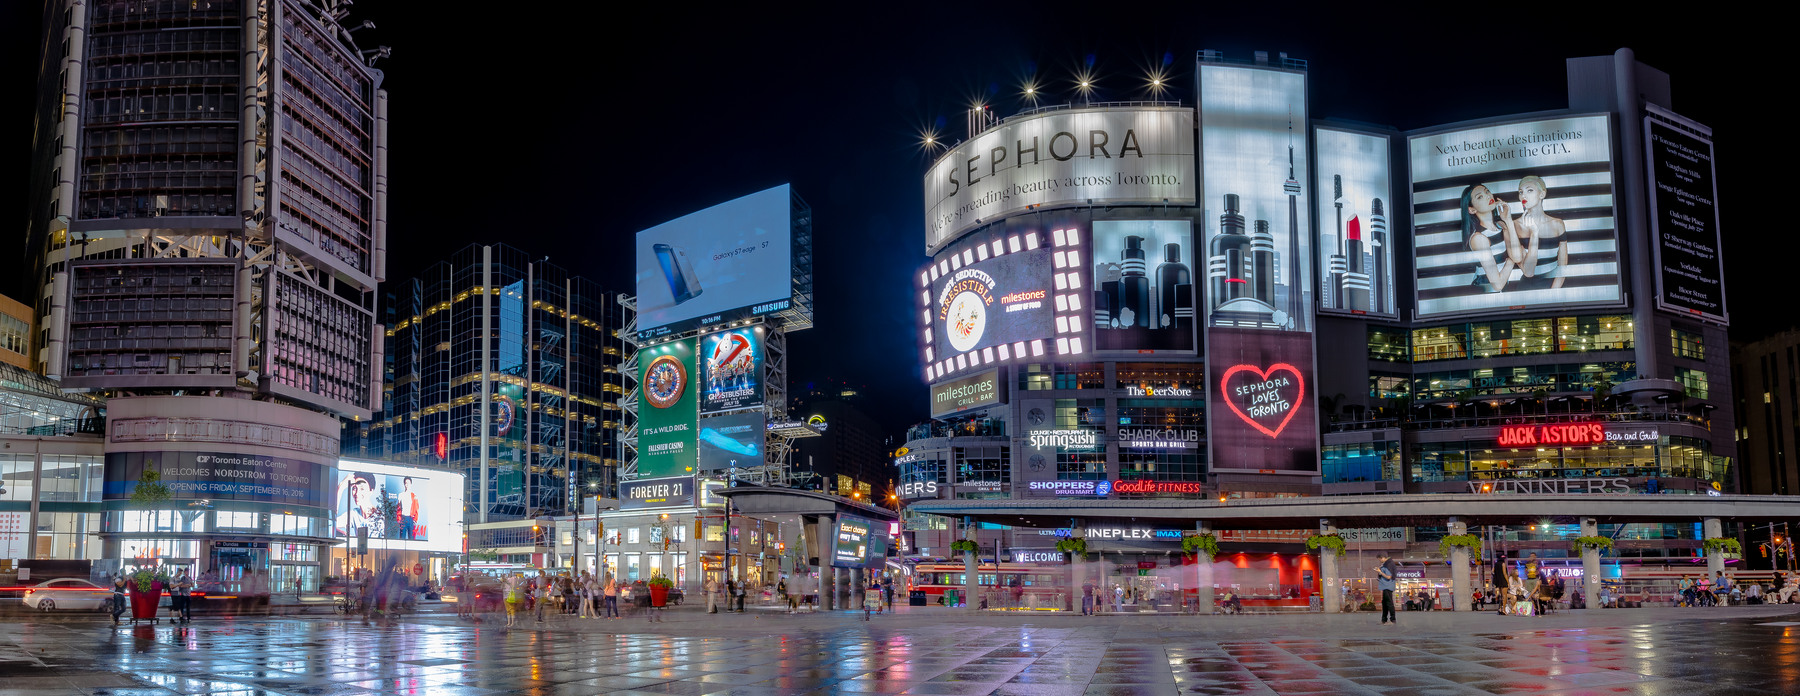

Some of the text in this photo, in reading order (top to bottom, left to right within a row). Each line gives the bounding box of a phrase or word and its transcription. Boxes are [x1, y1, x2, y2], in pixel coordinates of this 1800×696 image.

[1435, 129, 1583, 156] New beauty destinations
[1659, 136, 1680, 149] Toronto
[1679, 144, 1694, 155] Eaton
[1694, 150, 1711, 161] Centre
[1447, 143, 1571, 167] throughout the GTA.
[949, 128, 1143, 197] SEPHORA
[930, 171, 1181, 235] We're spreading beauty across Toronto.
[1695, 194, 1712, 206] Centre
[761, 240, 769, 249] S7
[1693, 241, 1714, 253] Gardens
[713, 246, 756, 261] Galaxy S7 edge
[955, 268, 996, 290] SEDUCTIVE
[940, 280, 994, 321] IRRESISTIBLE
[1001, 290, 1044, 304] milestones
[752, 300, 789, 315] SAMSUNG
[1480, 377, 1506, 387] DMZ
[1567, 373, 1594, 383] DMZ
[937, 379, 993, 403] milestones
[1126, 386, 1146, 396] The
[1236, 377, 1290, 396] SEPHORA
[957, 393, 993, 406] GRILL BAR
[1252, 388, 1280, 406] LOVES
[1247, 399, 1290, 419] TORONTO
[643, 428, 653, 436] IT'S
[658, 425, 674, 433] WILD
[674, 424, 689, 432] RIDE.
[1118, 429, 1198, 442] SHARK CLUB
[1499, 424, 1659, 445] JACK ASTOR'S Bar and Grill
[668, 441, 684, 451] CASINO
[1030, 430, 1095, 451] spring sushi
[211, 455, 241, 465] Toronto
[242, 457, 263, 467] Eaton
[265, 459, 288, 469] Centre
[894, 454, 916, 466] PLEX
[163, 467, 310, 485] WELCOMES NORDSTROM TO TORONTO
[169, 482, 304, 498] OPENING FRIDAY, SEPTEMBER 16, 2016
[630, 483, 683, 499] FOREVER 21
[1029, 481, 1095, 490] SHOPPERS
[1113, 480, 1200, 493] GoodLife FITNESS
[1467, 477, 1631, 495] WINNERS
[1084, 528, 1152, 539] INEPLEX
[1156, 530, 1182, 538] IMAX
[1382, 531, 1402, 539] 2016
[1015, 552, 1063, 562] WELCOME
